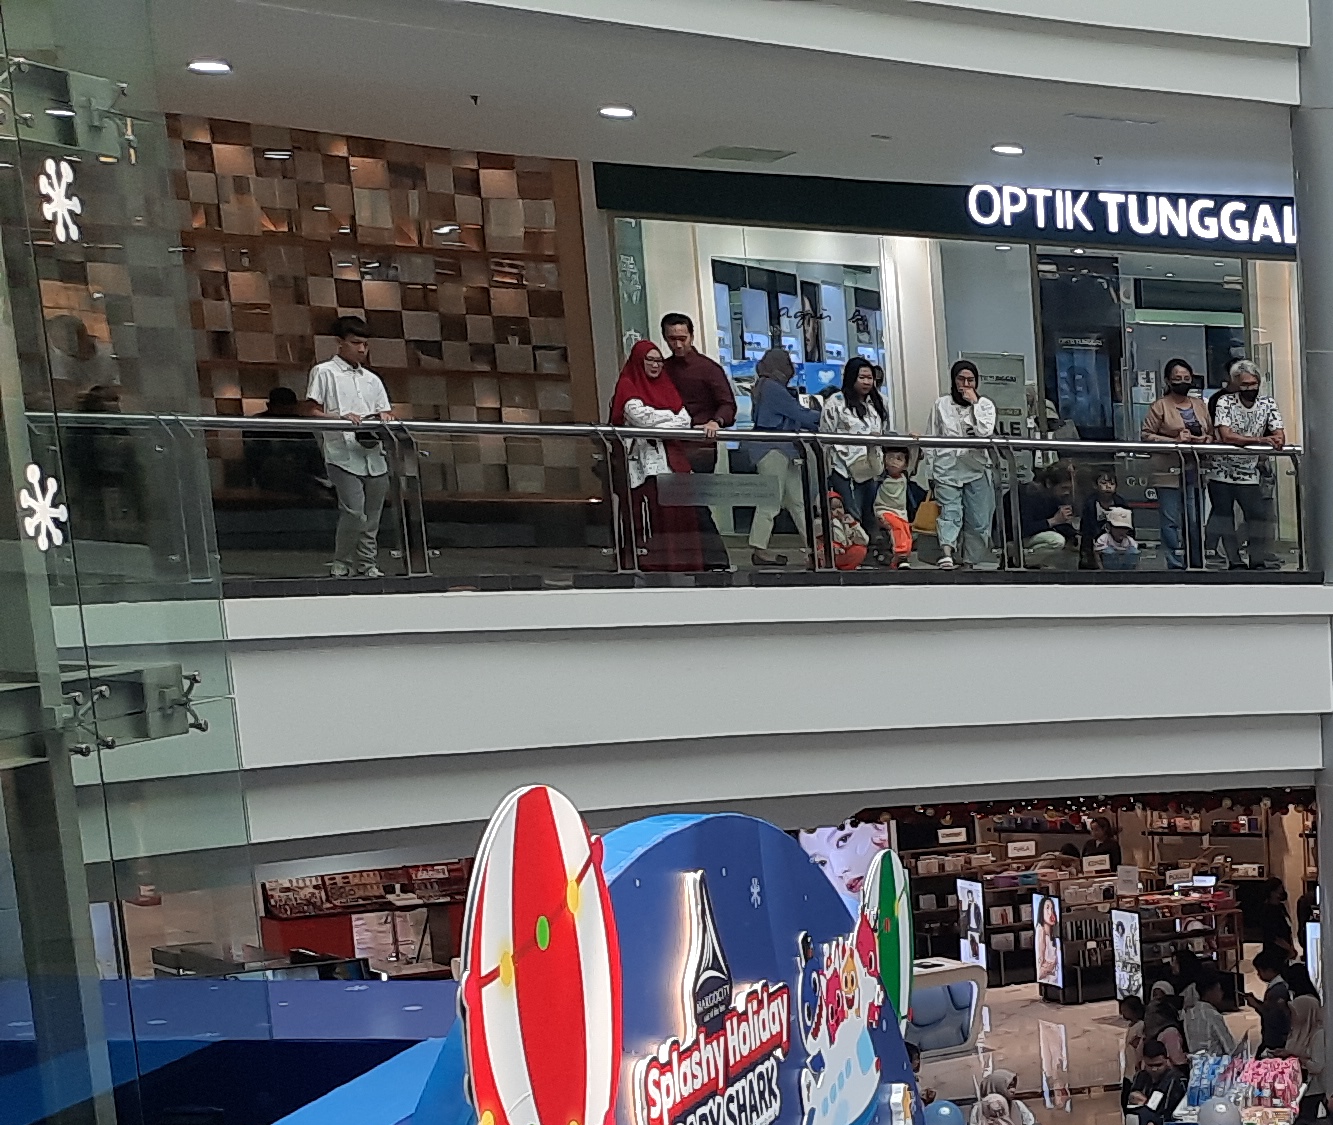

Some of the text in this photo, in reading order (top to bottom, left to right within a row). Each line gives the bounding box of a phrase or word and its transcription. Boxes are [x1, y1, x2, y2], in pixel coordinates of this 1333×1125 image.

[968, 184, 1296, 244] OPTIK TUNGGAL
[726, 990, 788, 1067] Holiday
